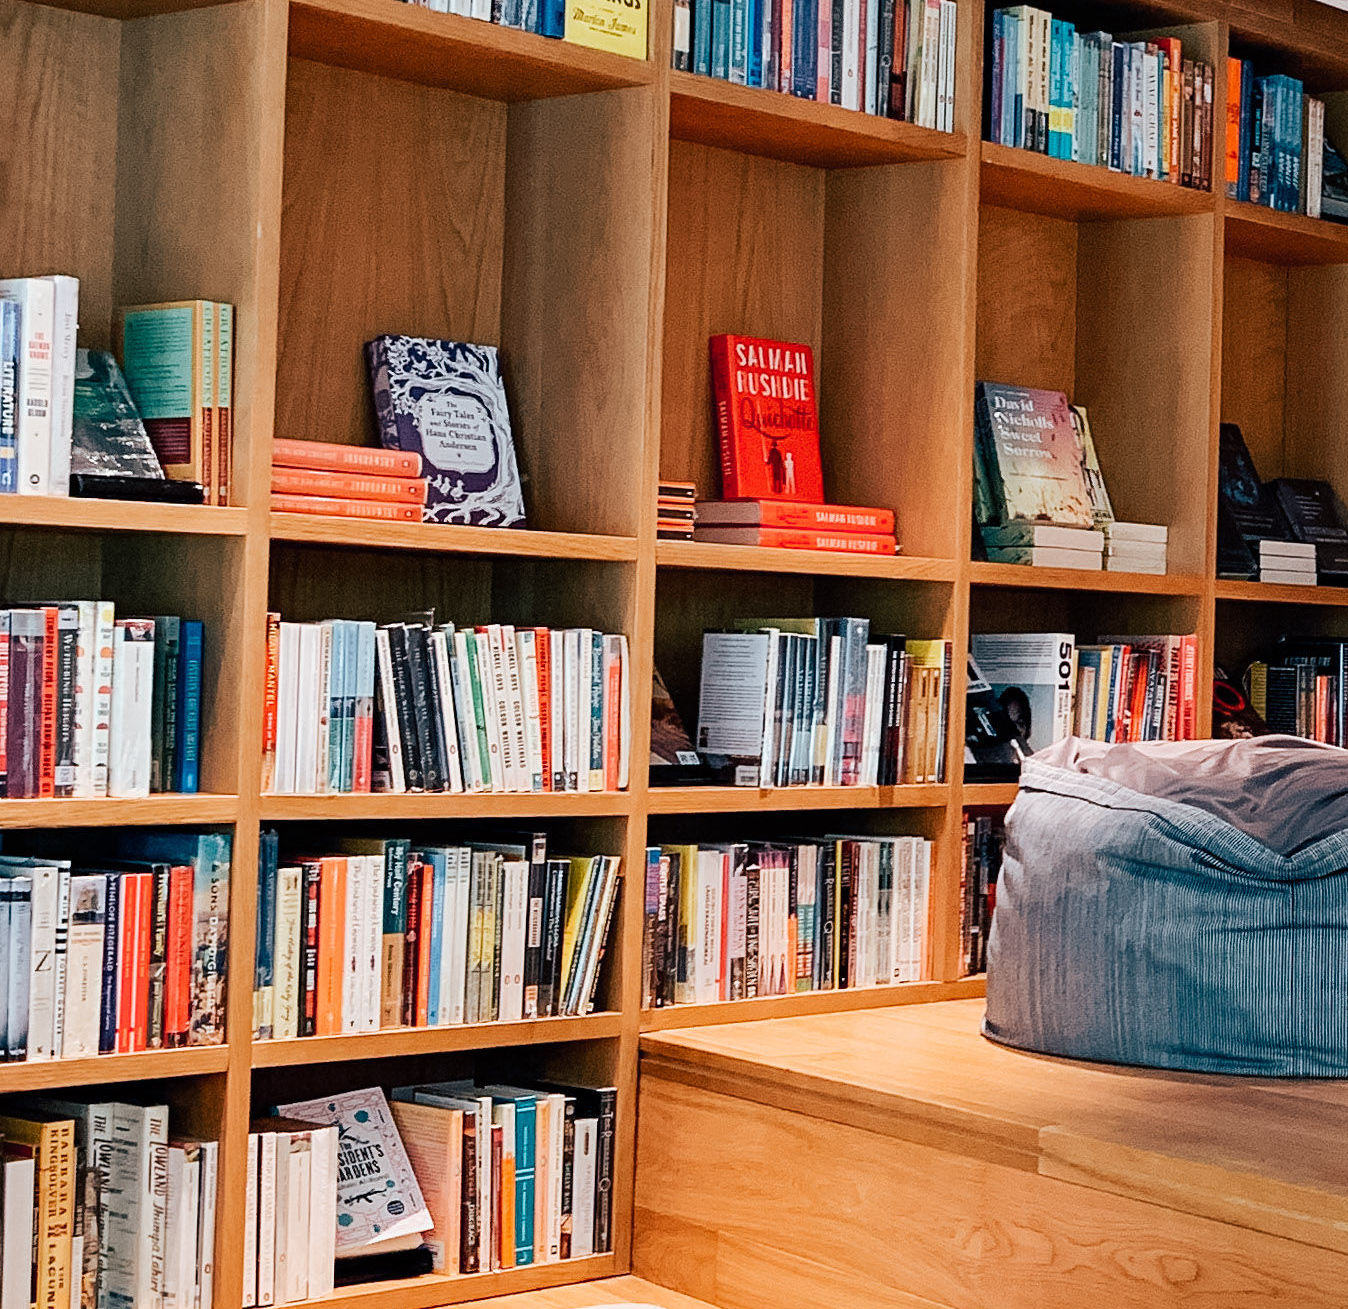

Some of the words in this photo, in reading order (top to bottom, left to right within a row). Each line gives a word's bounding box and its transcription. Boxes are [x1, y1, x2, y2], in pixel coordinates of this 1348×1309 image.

[736, 344, 808, 374] SALMAN
[2, 361, 15, 435] LITERATURE
[736, 371, 810, 401] RUSHDIE
[431, 408, 452, 419] Fairy
[454, 410, 475, 419] Tales
[994, 412, 1054, 429] Nicholls
[995, 396, 1034, 413] David
[425, 429, 447, 437] Hans
[1058, 642, 1072, 691] 501
[265, 665, 276, 707] MANTEL
[394, 846, 404, 860] My
[392, 862, 403, 879] Half
[108, 881, 117, 921] PENELOPE
[210, 877, 218, 911] SONS
[390, 881, 402, 916] Century
[107, 924, 116, 971] FITZGERALD
[93, 1115, 107, 1134] THE
[150, 1118, 162, 1136] THE
[338, 1143, 385, 1167] SIDENT'S
[47, 1129, 58, 1218] KINGSOLVER
[59, 1128, 69, 1217] BARBARA
[150, 1141, 168, 1202] LOWLAND
[337, 1160, 381, 1183] ARDENS
[148, 1202, 164, 1252] Jhumpa
[150, 1254, 163, 1293] Lahiri
